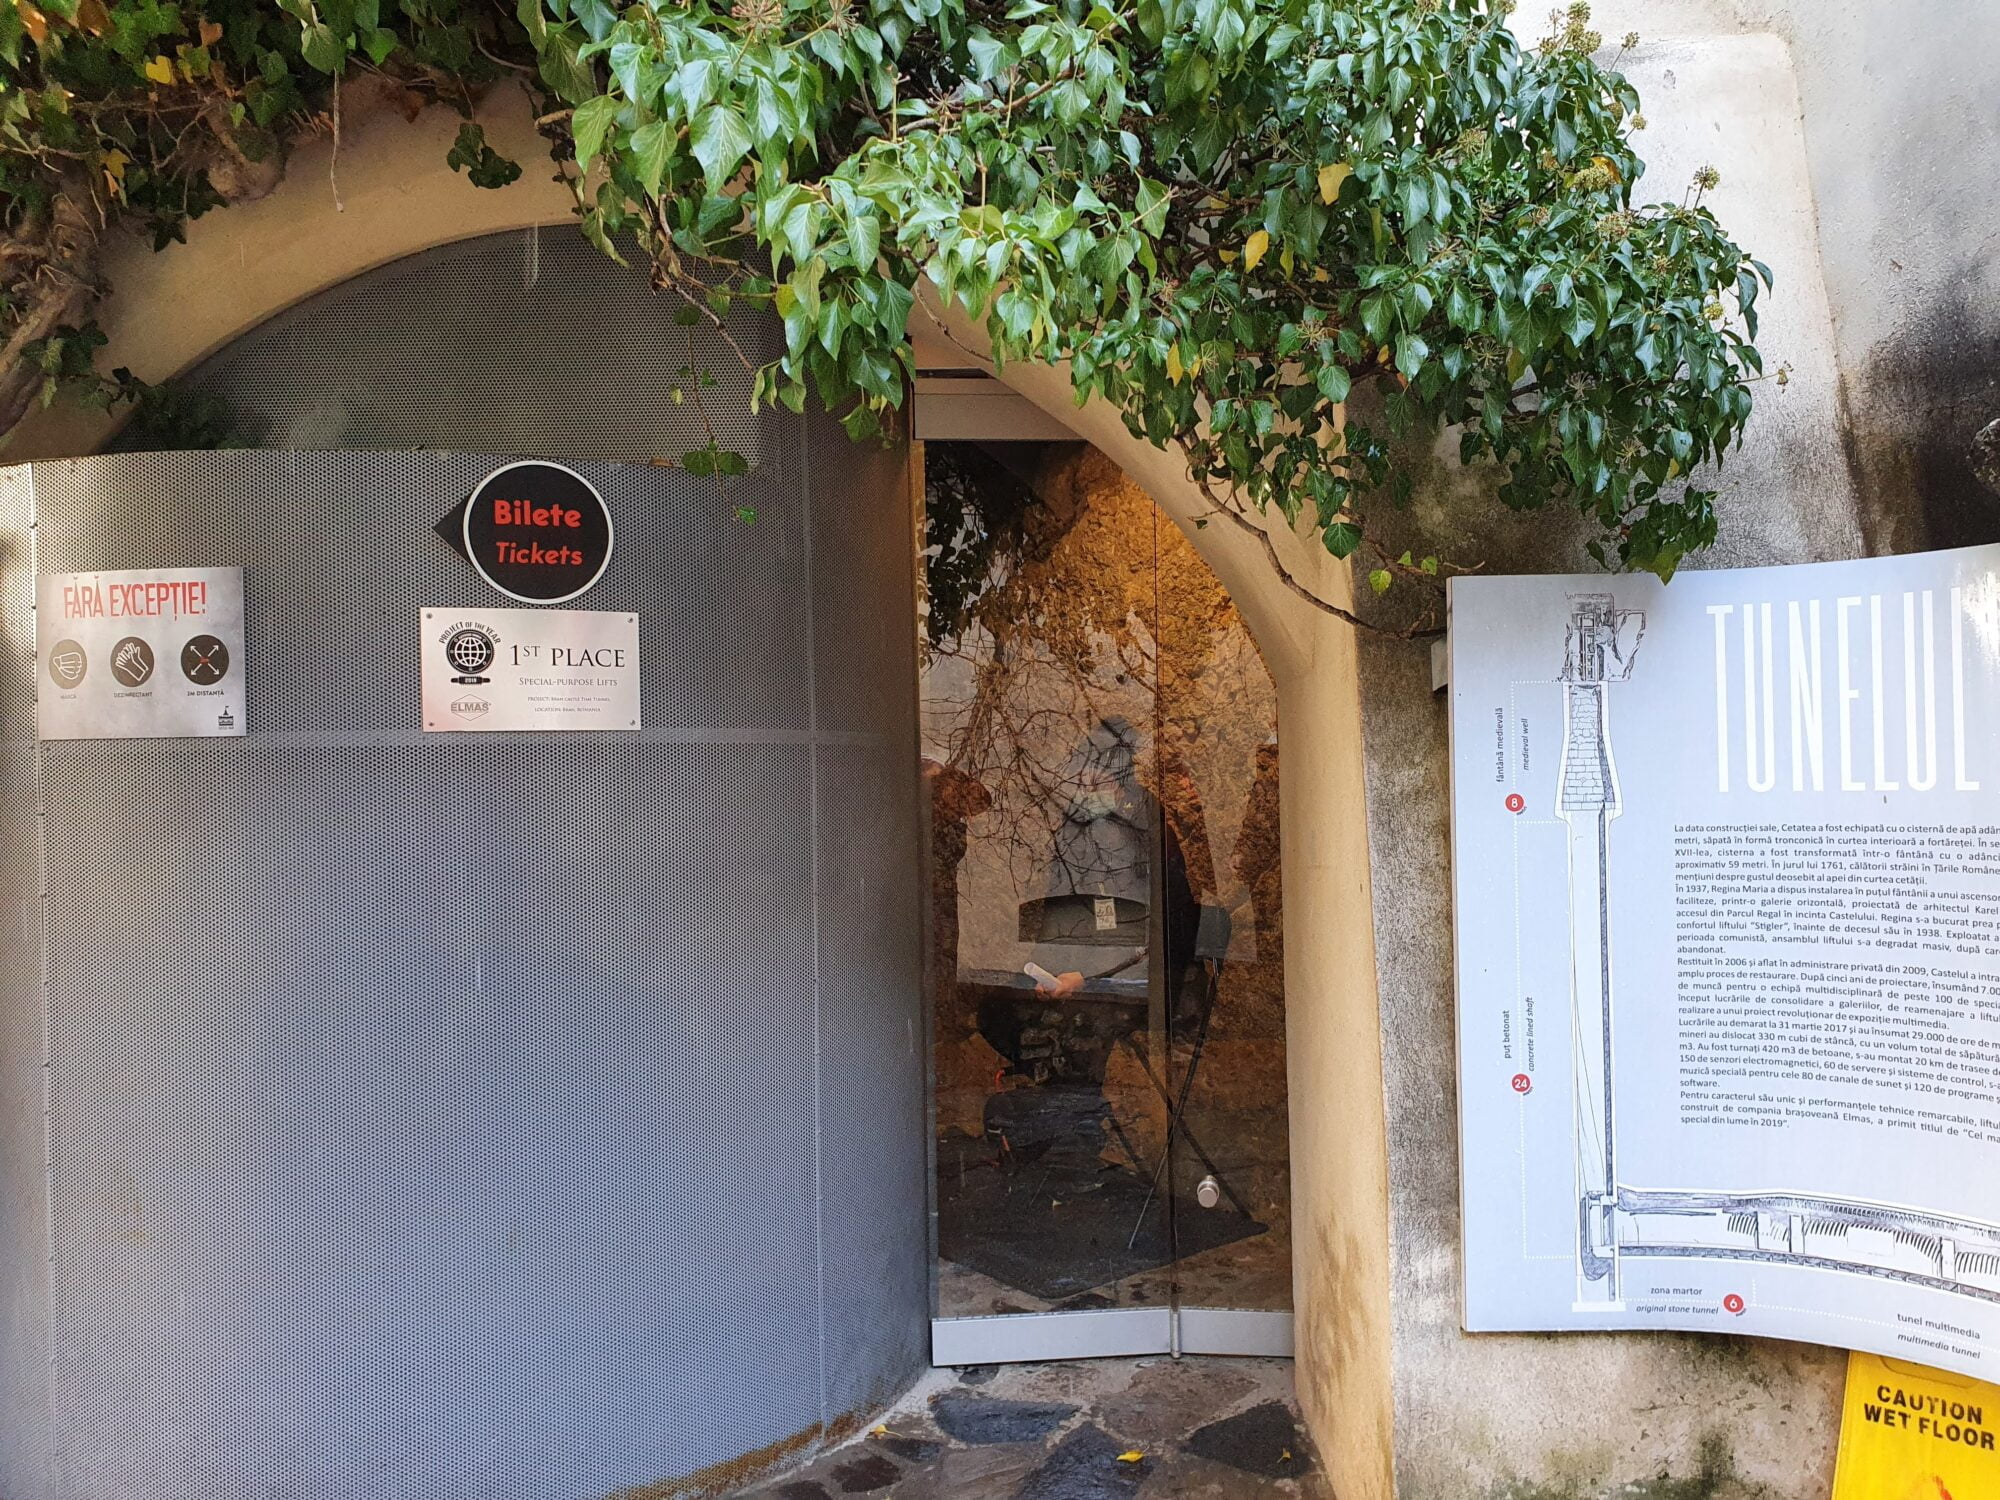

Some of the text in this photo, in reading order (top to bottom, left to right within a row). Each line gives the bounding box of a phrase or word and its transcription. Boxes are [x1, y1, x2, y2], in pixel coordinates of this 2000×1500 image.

[494, 500, 581, 527] Bilete
[496, 542, 583, 565] Tickets
[63, 575, 206, 621] FĂRĂ EXCEPȚIE!
[439, 622, 463, 644] PROJECT
[474, 622, 486, 631] THE
[485, 626, 501, 644] YEAR
[550, 648, 625, 668] PLACE
[1706, 587, 1980, 793] TUNELUL
[1495, 708, 1504, 782] fântână medievală
[1512, 798, 1518, 808] 8
[1706, 824, 1758, 833] construcției
[1760, 824, 1779, 832] sale,
[1782, 824, 1816, 832] Cetatea
[1826, 824, 1842, 832] fost
[1844, 824, 1884, 833] echipată
[1907, 825, 1944, 833] cisternă
[1946, 825, 1958, 833] de
[1960, 826, 1976, 835] apă
[1675, 837, 1700, 845] metri,
[1703, 836, 1732, 845] săpată
[1734, 836, 1742, 844] în
[1746, 836, 1772, 844] formă
[1775, 836, 1823, 844] tronconică
[1826, 836, 1834, 844] în
[1871, 837, 1916, 846] interioară
[1928, 838, 1975, 848] fortăreței.
[1978, 838, 1987, 847] În
[1676, 861, 1726, 870] aproximativ
[1771, 859, 1780, 868] În
[1783, 861, 1804, 870] jurul
[1807, 861, 1818, 869] lui
[1822, 862, 1846, 870] 1761,
[1850, 862, 1886, 870] călătorii
[1890, 863, 1919, 871] străini
[1922, 864, 1930, 872] în
[1933, 864, 1959, 873] Țările
[1676, 873, 1714, 882] mențiuni
[1716, 873, 1745, 882] despre
[1746, 873, 1774, 882] gustul
[1776, 873, 1815, 881] deosebit
[1826, 874, 1846, 883] apei
[1848, 874, 1862, 882] din
[1896, 876, 1927, 886] cetății.
[1676, 897, 1998, 915] faciliteze, printr-o galerie orizontală, proiectată de arhitectul Karel
[1725, 958, 1747, 966] 2006
[1749, 959, 1756, 968] și
[1758, 959, 1778, 967] aflat
[1779, 959, 1788, 967] în
[1790, 960, 1848, 970] administrare
[1851, 964, 1883, 972] privată
[1886, 965, 1900, 973] din
[1902, 966, 1928, 976] 2009,
[1931, 968, 1968, 979] Castelul
[1525, 997, 1534, 1016] shaft
[1679, 1006, 1714, 1014] realizare
[1744, 1008, 1776, 1016] proiect
[1777, 1010, 1834, 1019] revoluționar
[1835, 1012, 1847, 1020] de
[1848, 1014, 1891, 1024] expoziție
[1893, 1018, 1950, 1029] multimedia.
[1502, 1010, 1512, 1059] puț betonat
[1680, 1079, 1720, 1087] software.
[1743, 1056, 1822, 1069] electromagnetici,
[1824, 1061, 1835, 1069] 60
[1838, 1062, 1849, 1070] de
[1851, 1065, 1886, 1074] servere
[1888, 1068, 1896, 1076] și
[1898, 1068, 1934, 1080] sisteme
[1936, 1073, 1948, 1082] de
[1950, 1076, 1986, 1088] control,
[1514, 1079, 1527, 1088] 24
[1681, 1091, 1709, 1099] Pentru
[1758, 1094, 1773, 1102] său
[1798, 1097, 1805, 1106] și
[1808, 1098, 1876, 1111] performanțele
[1879, 1105, 1914, 1116] tehnice
[1918, 1111, 1977, 1126] remarcabile,
[1636, 1304, 1666, 1313] original
[1692, 1306, 1719, 1314] tunnel
[1730, 1298, 1738, 1308] 6
[1897, 1313, 1981, 1340] tunel multimedia
[1897, 1333, 1981, 1359] multimedia tunnel
[1877, 1384, 1983, 1425] CAUTION
[1864, 1403, 1994, 1450] WET FLOOR
